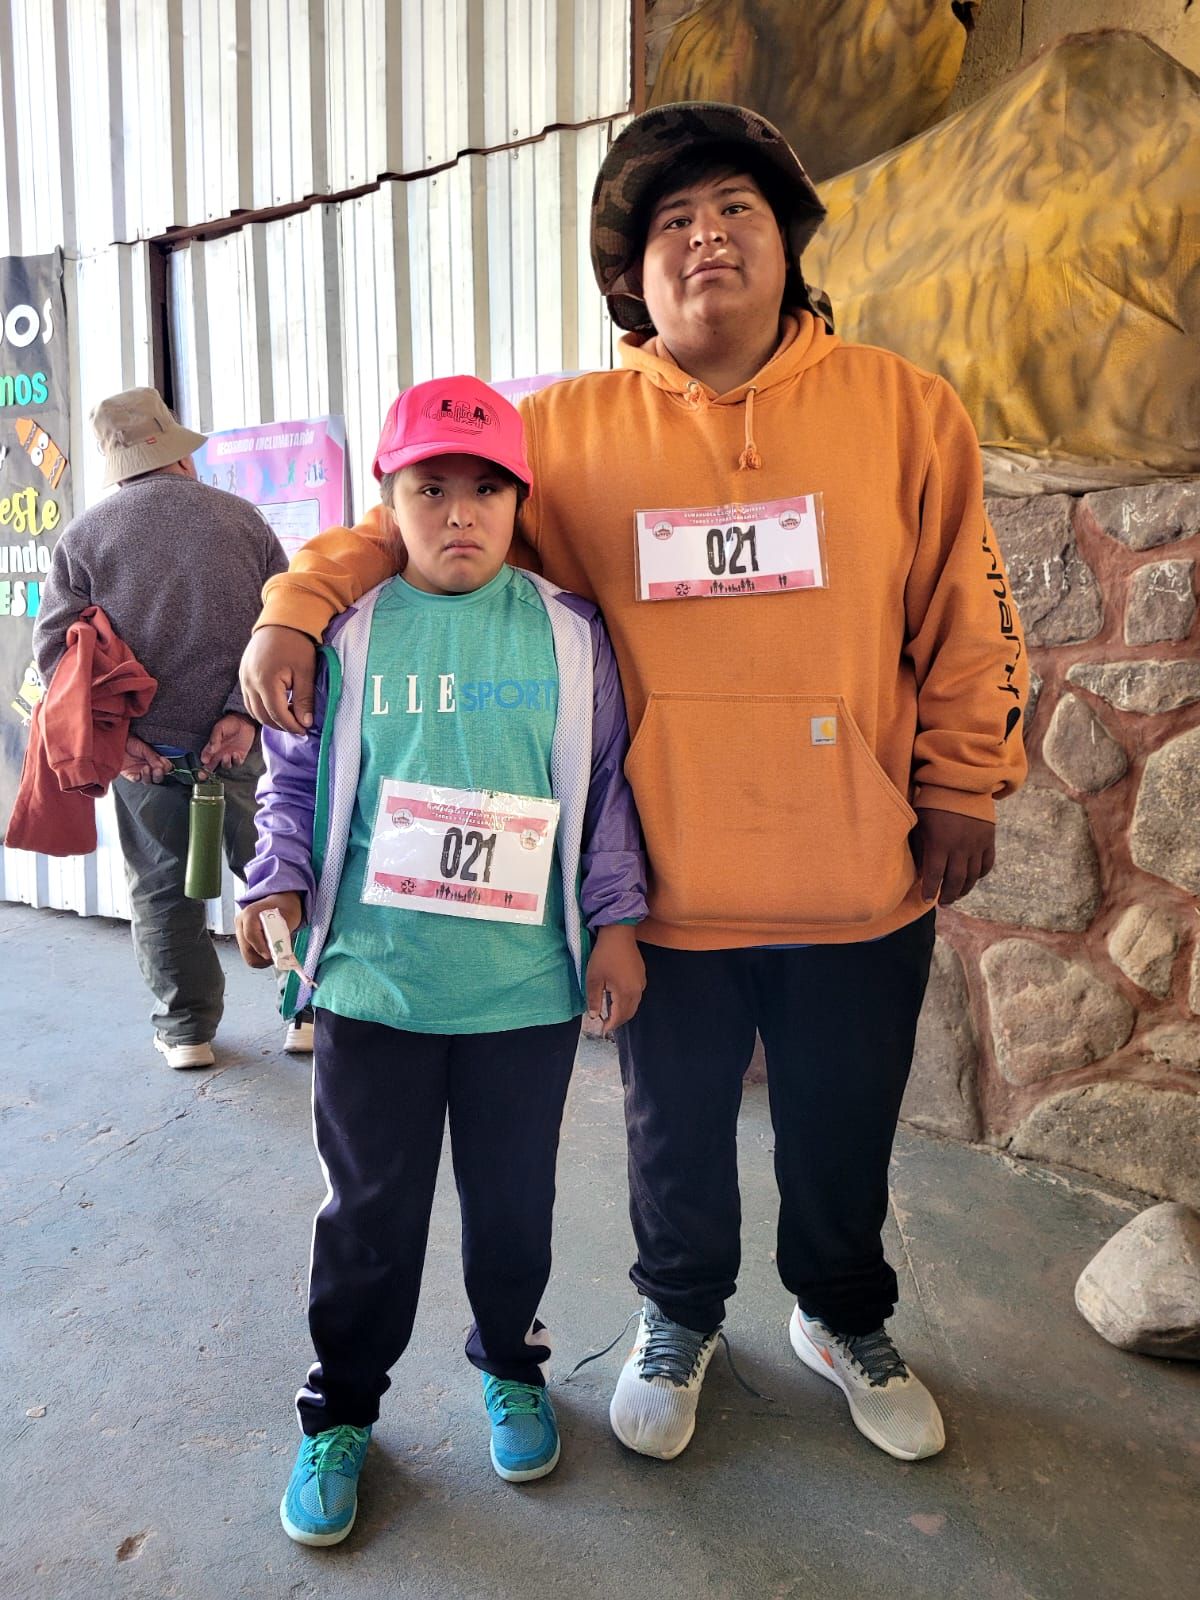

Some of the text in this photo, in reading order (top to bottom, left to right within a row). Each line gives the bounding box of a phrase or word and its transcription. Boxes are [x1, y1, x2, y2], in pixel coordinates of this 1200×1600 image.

[0, 298, 54, 348] OS
[706, 525, 759, 576] 021
[461, 678, 557, 712] SPORT
[440, 826, 497, 883] 021
